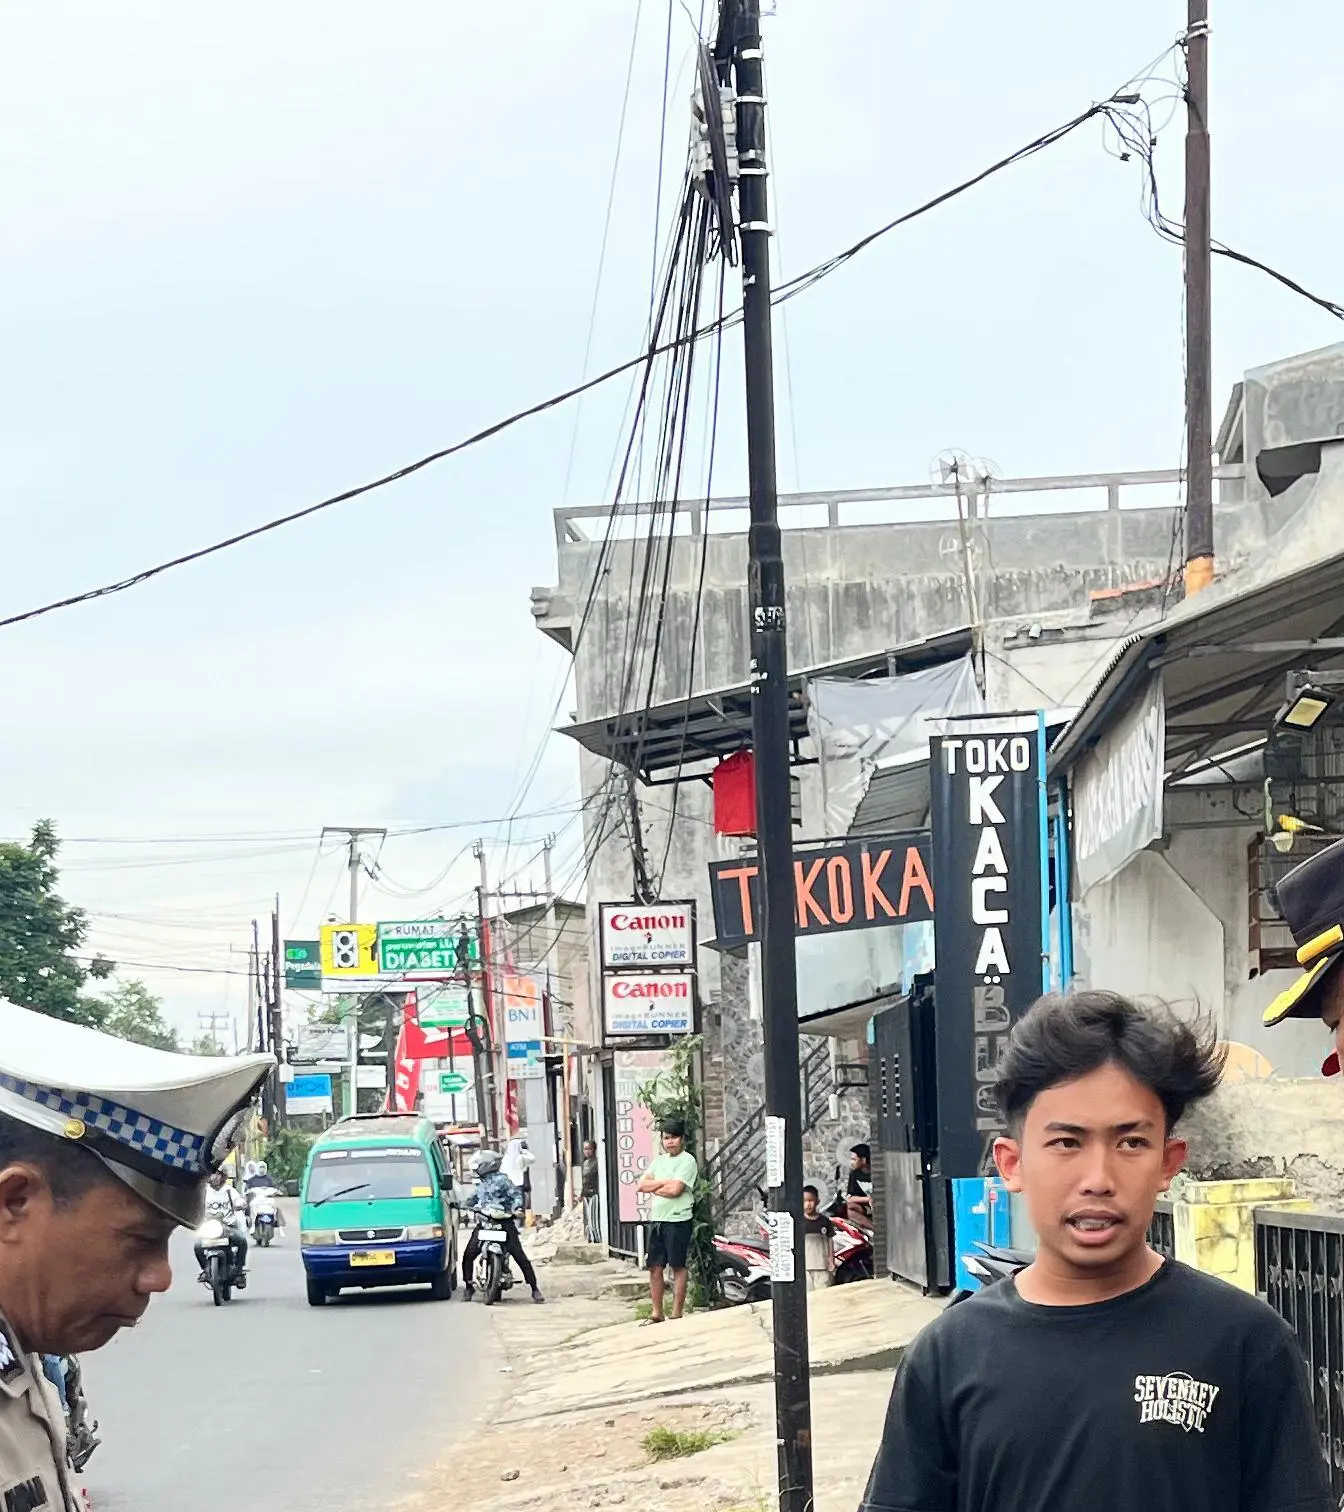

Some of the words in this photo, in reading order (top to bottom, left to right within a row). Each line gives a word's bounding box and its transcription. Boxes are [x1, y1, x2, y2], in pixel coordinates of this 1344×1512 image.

[940, 737, 1032, 776] TOKO
[968, 775, 1012, 976] KACA
[717, 856, 854, 936] TKO
[610, 914, 686, 932] Canon
[612, 951, 649, 961] DIGITAL
[651, 949, 687, 960] COPIER
[612, 981, 688, 999] Canon
[508, 1008, 537, 1022] BNI
[651, 1018, 688, 1029] COPIER
[617, 1100, 635, 1186] PHOTO
[635, 1155, 652, 1222] CPY
[1133, 1374, 1220, 1414] SEVENKEY
